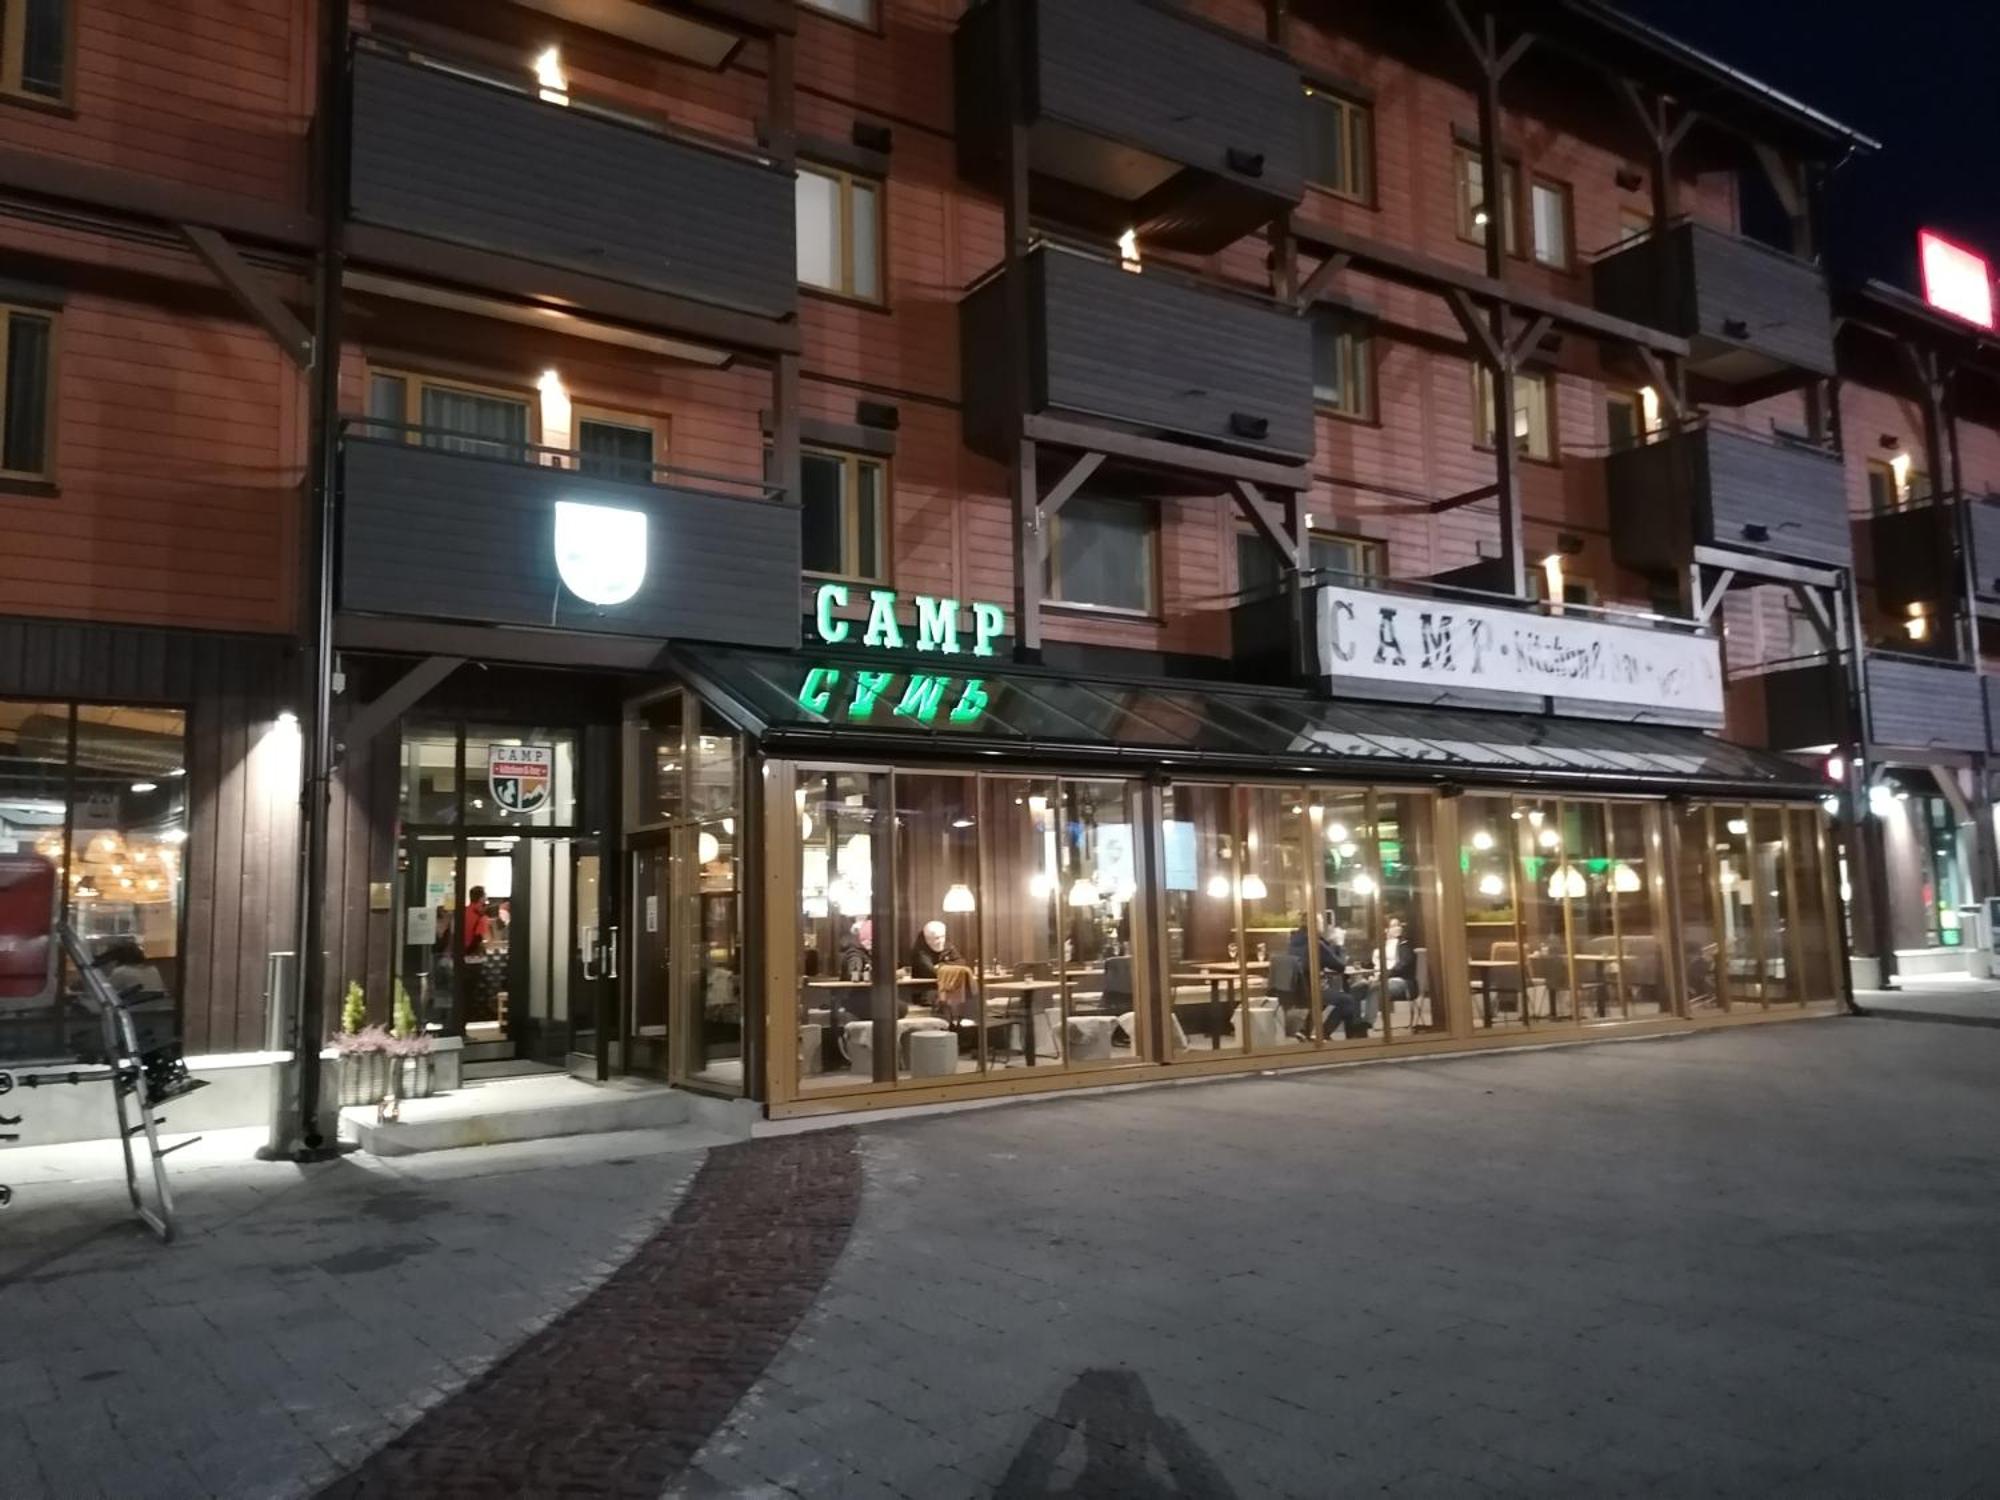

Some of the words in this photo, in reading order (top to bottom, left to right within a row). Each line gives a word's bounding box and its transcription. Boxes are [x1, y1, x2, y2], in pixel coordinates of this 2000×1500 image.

[816, 584, 1005, 657] CAMP
[1330, 600, 1492, 674] CAMP
[498, 748, 543, 762] CAMP
